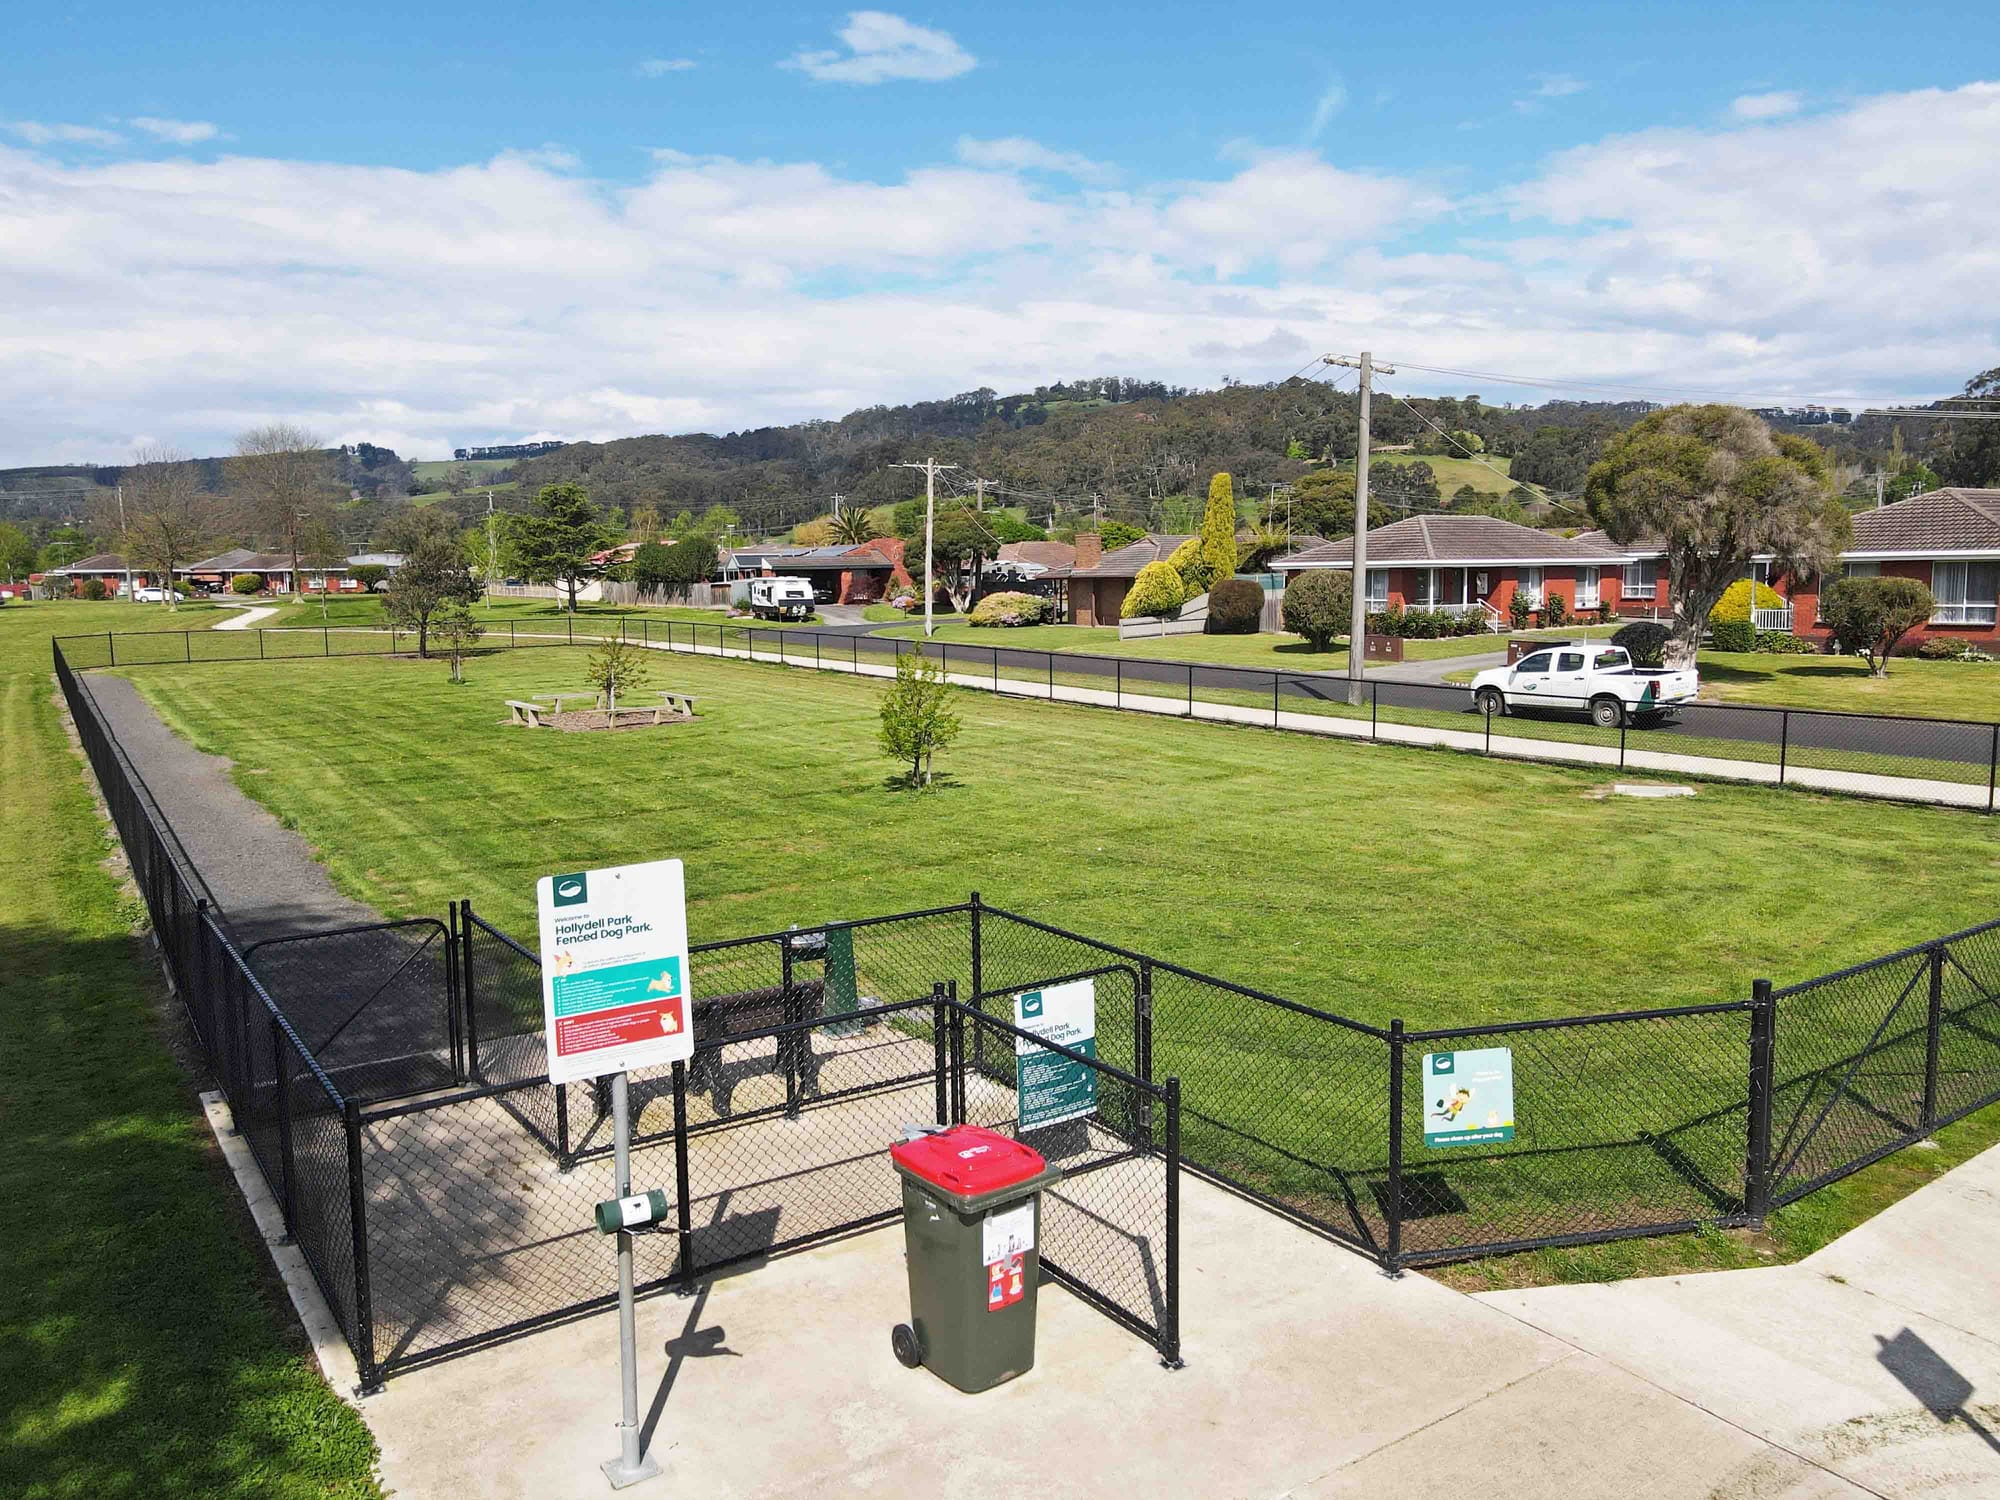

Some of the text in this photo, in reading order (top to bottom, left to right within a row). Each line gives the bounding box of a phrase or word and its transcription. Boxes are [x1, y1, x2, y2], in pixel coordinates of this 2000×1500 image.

[554, 914, 582, 923] Welcome
[555, 914, 633, 935] Hollydell Park
[556, 922, 653, 946] Fenced Dog Park.
[1032, 1026, 1053, 1037] llydell
[1054, 1022, 1070, 1031] Park
[1050, 1032, 1065, 1041] Dog
